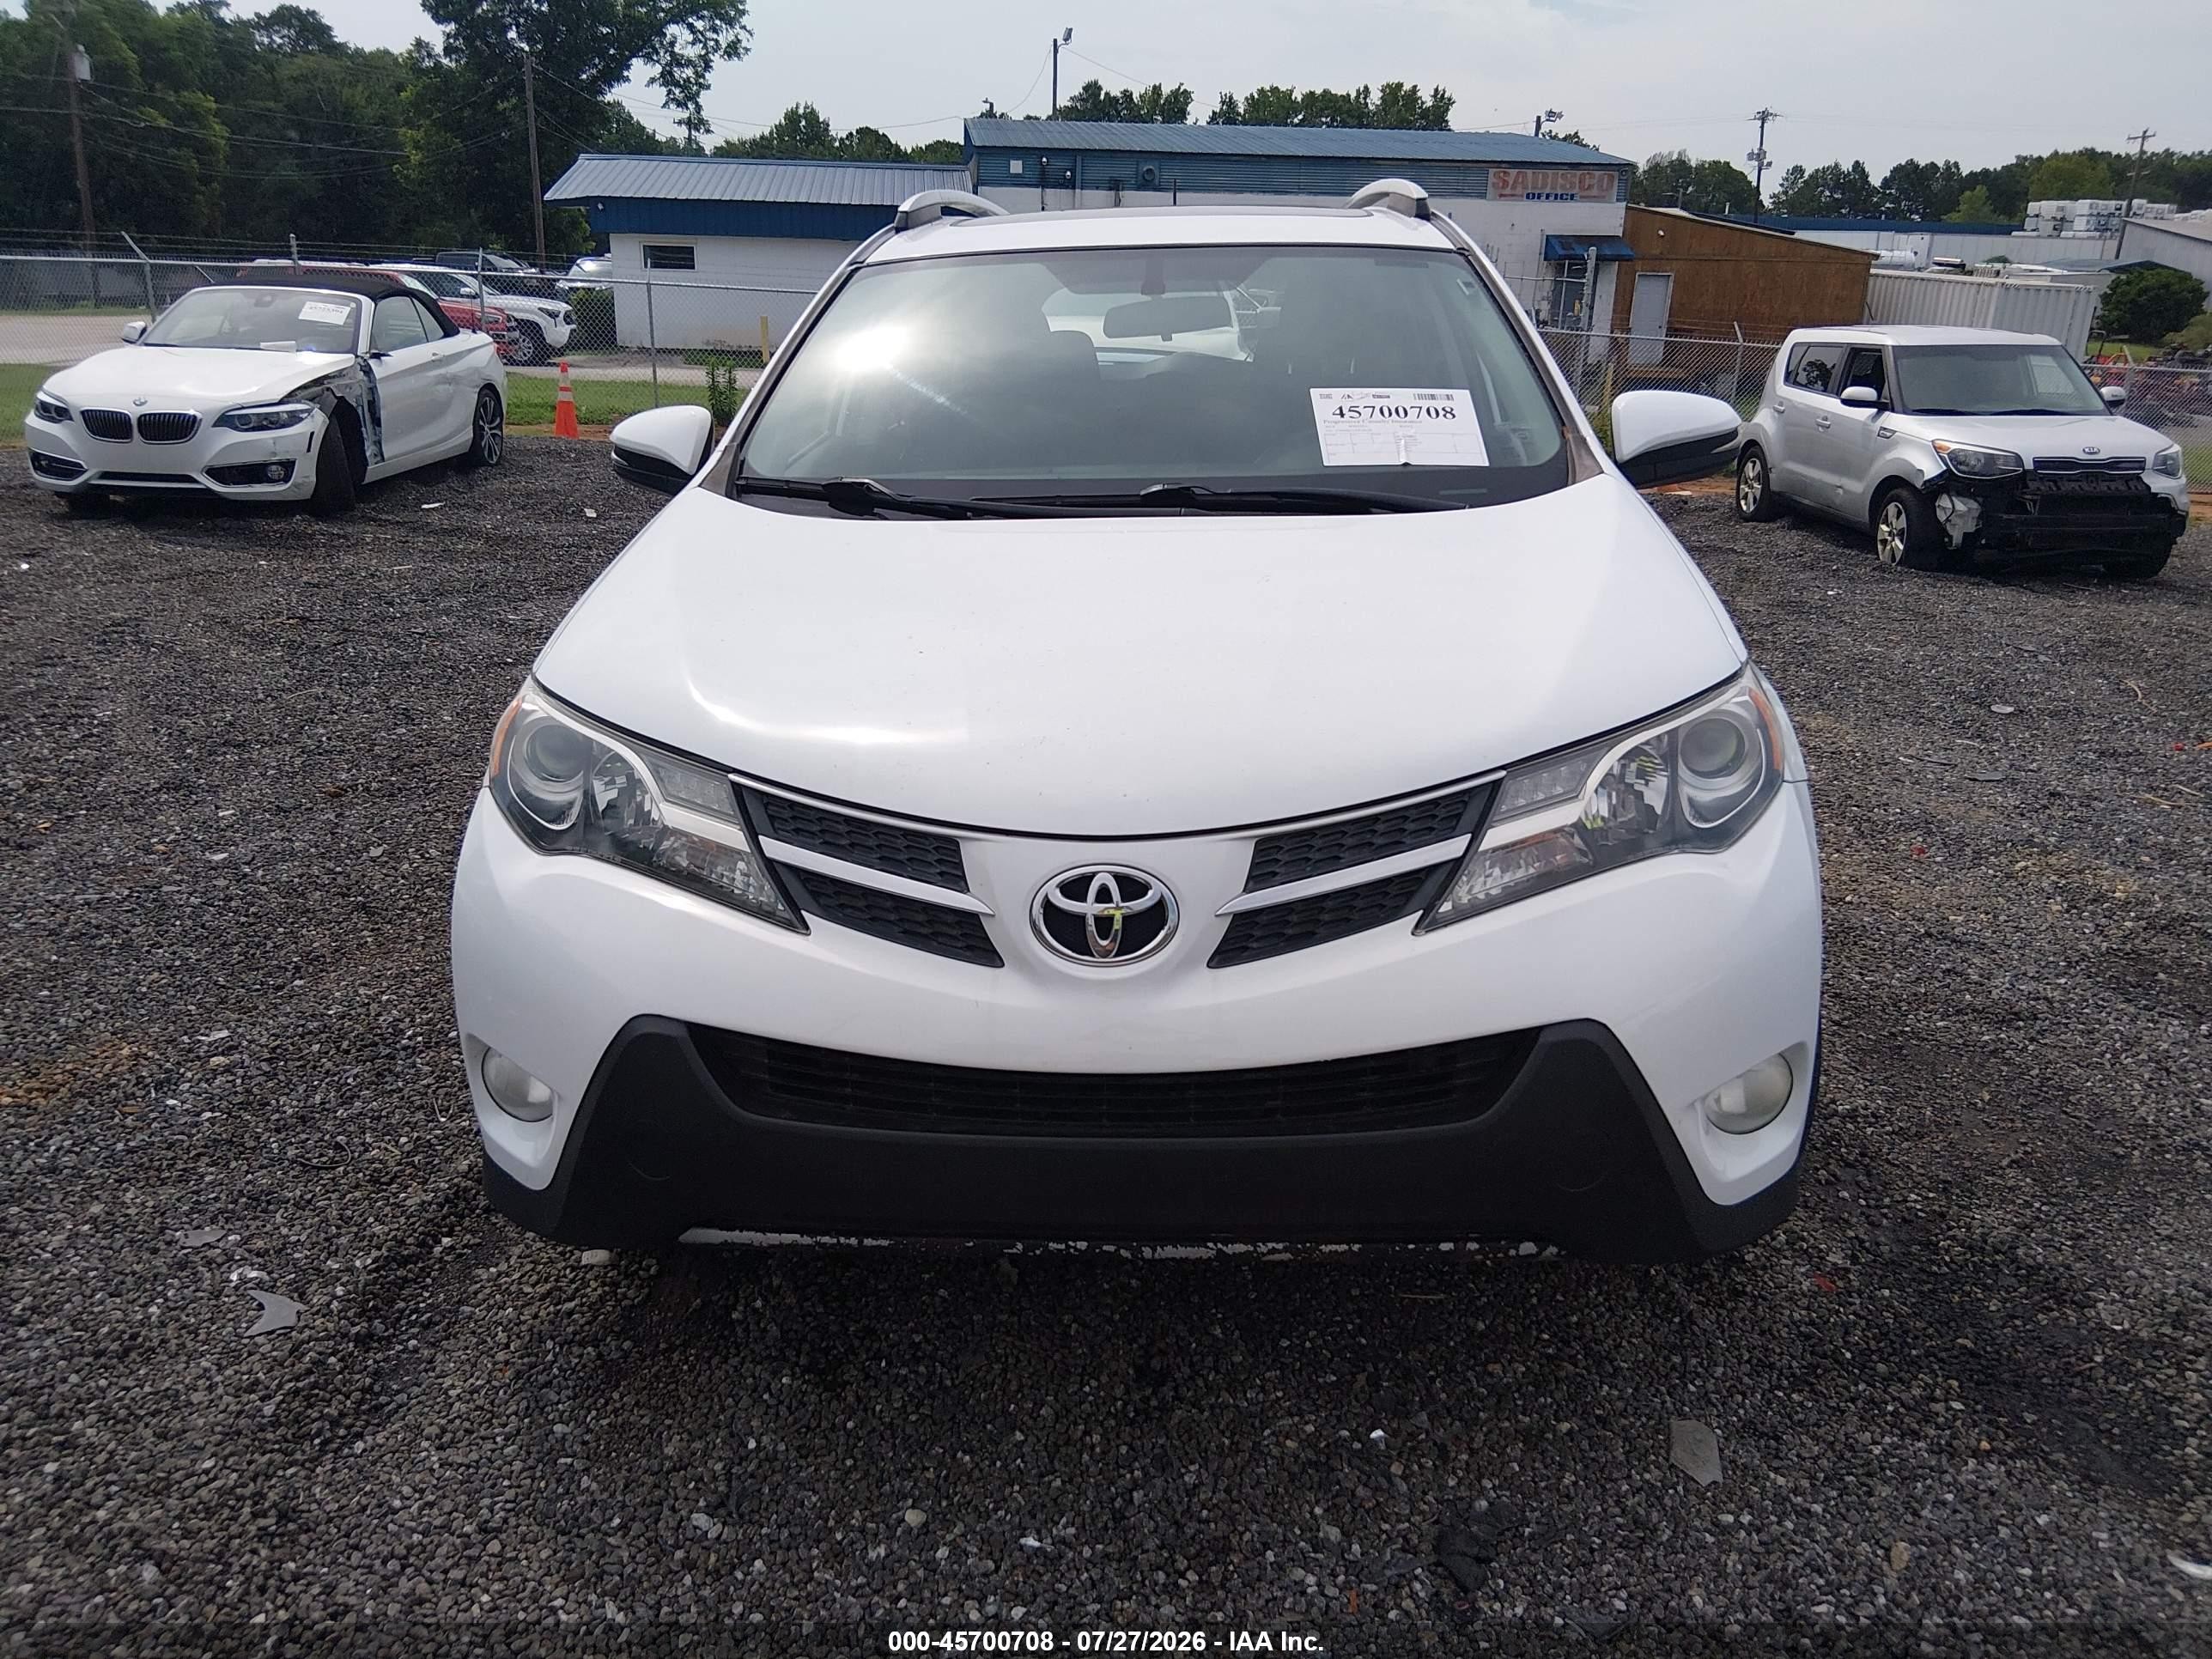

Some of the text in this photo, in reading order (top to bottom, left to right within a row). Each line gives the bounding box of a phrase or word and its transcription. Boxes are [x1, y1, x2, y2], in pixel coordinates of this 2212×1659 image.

[1492, 170, 1615, 192] SADISCO
[1525, 192, 1579, 201] OFFICE
[1332, 404, 1457, 420] 45700708
